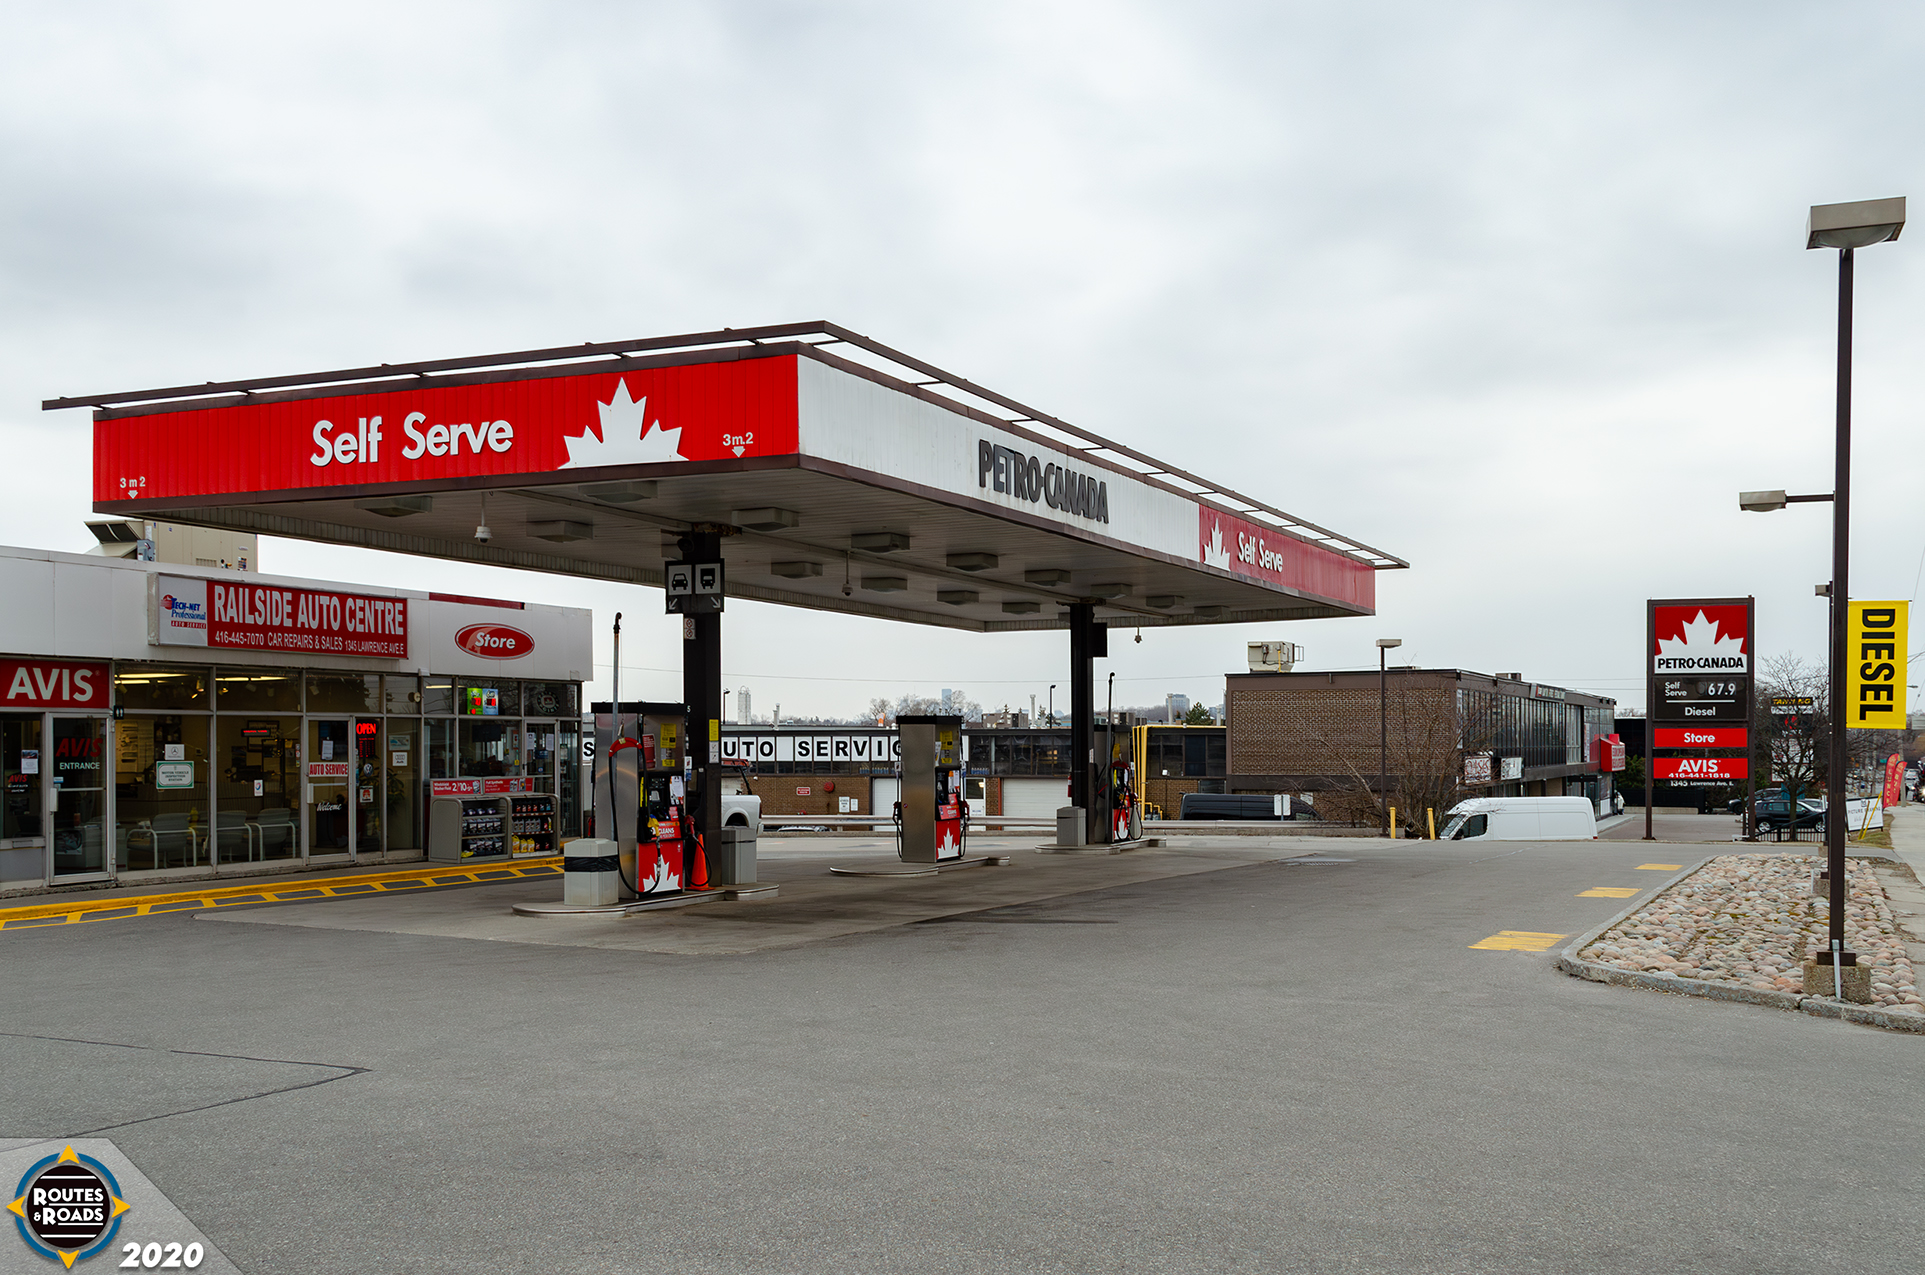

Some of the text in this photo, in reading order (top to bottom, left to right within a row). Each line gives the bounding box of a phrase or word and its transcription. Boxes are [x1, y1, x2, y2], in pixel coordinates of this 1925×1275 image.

[310, 412, 513, 466] Self Serve
[1237, 531, 1283, 573] Self Serve
[171, 609, 206, 621] Professional
[214, 585, 404, 636] RAILSIDE AUTO CENTRE
[215, 631, 265, 646] 416-445-7070
[267, 632, 284, 647] CAR
[284, 634, 313, 649] REPAIRS
[314, 637, 320, 649] &
[321, 637, 343, 651] SALES
[345, 641, 357, 651] 1345
[358, 641, 388, 653] LAWRENCE
[475, 632, 516, 649] Store
[1657, 657, 1744, 669] PETRO-CANADA
[1859, 608, 1895, 721] DIESEL
[7, 667, 93, 702] AVIS
[1665, 682, 1736, 696] Self 67.9
[1685, 706, 1716, 716] Diesel
[356, 723, 377, 735] OPEN
[1684, 732, 1715, 743] Store
[55, 738, 104, 758] AVIS
[723, 741, 774, 757] UTO
[60, 762, 100, 770] ENTRANCE
[309, 764, 348, 775] AUTO SERVICE
[1678, 759, 1719, 773] AVIS
[8, 774, 28, 784] AVIS
[317, 802, 341, 811] Welcome
